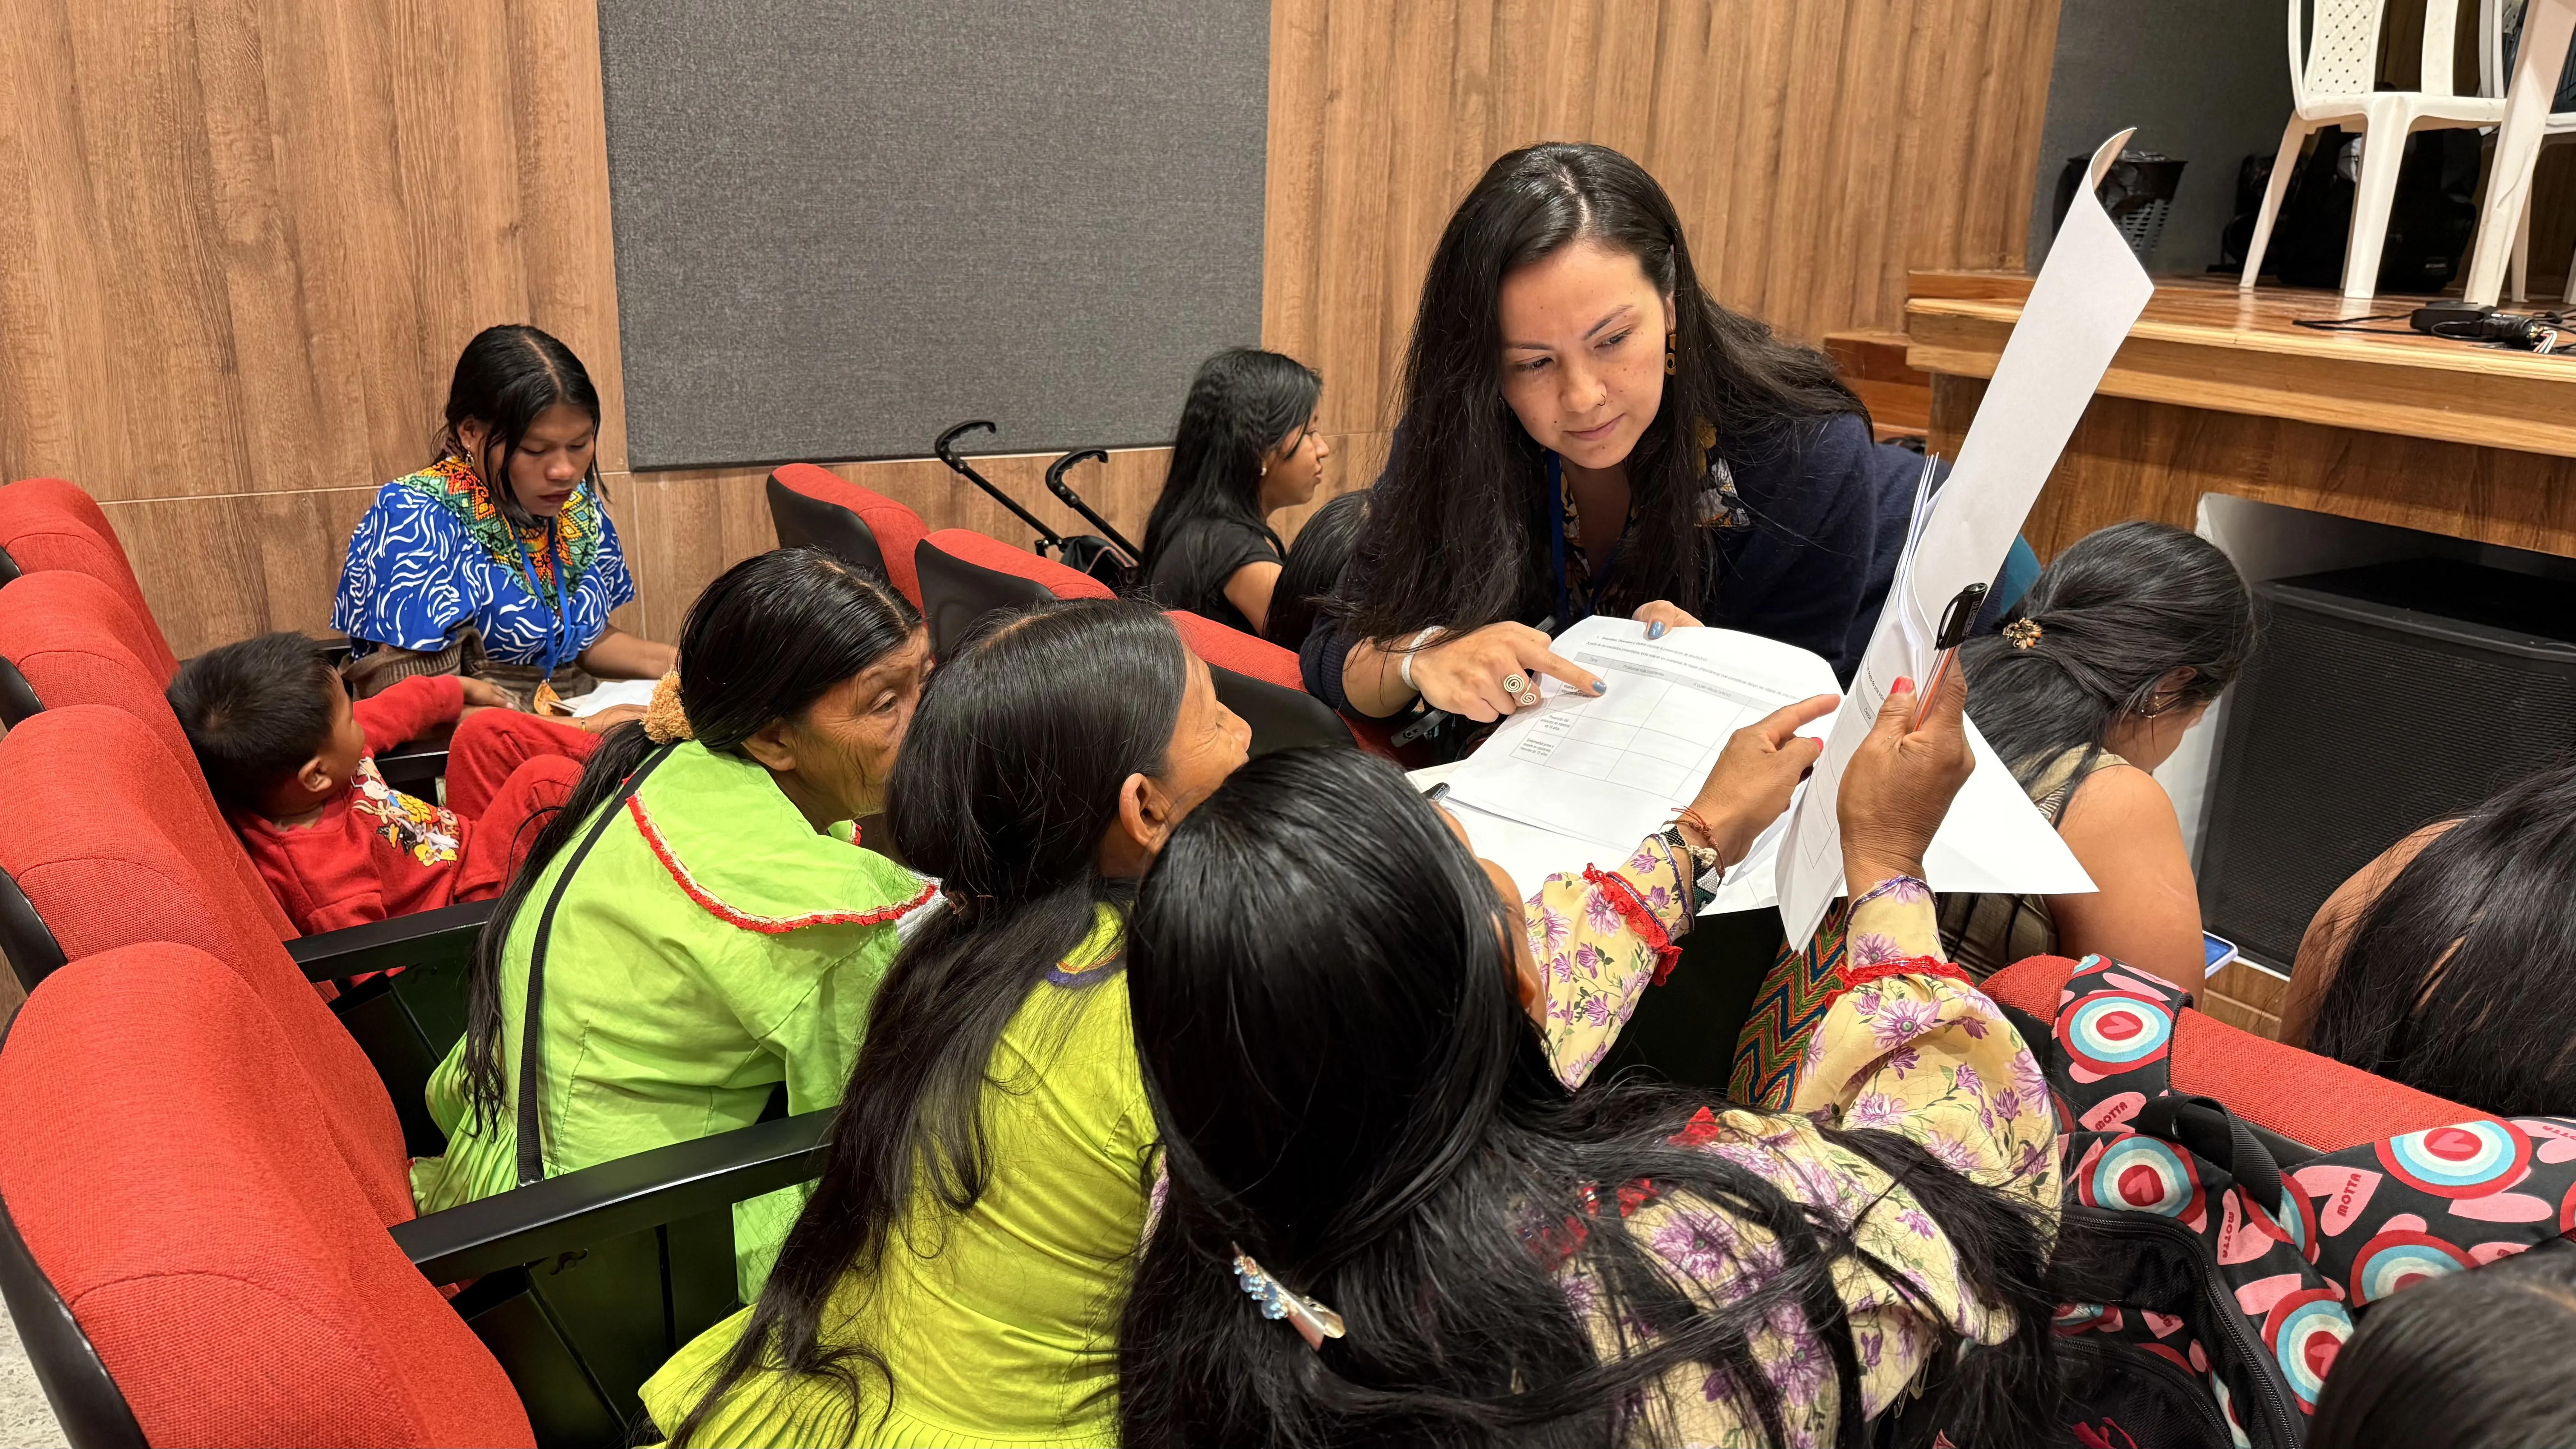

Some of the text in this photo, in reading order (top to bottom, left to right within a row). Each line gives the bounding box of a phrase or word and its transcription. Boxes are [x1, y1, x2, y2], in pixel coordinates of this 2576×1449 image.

[2094, 1101, 2128, 1131] MOTTA
[2542, 1126, 2576, 1141] OTTA
[2337, 1173, 2362, 1217] MOTTA
[2222, 1211, 2234, 1259] MOTTA
